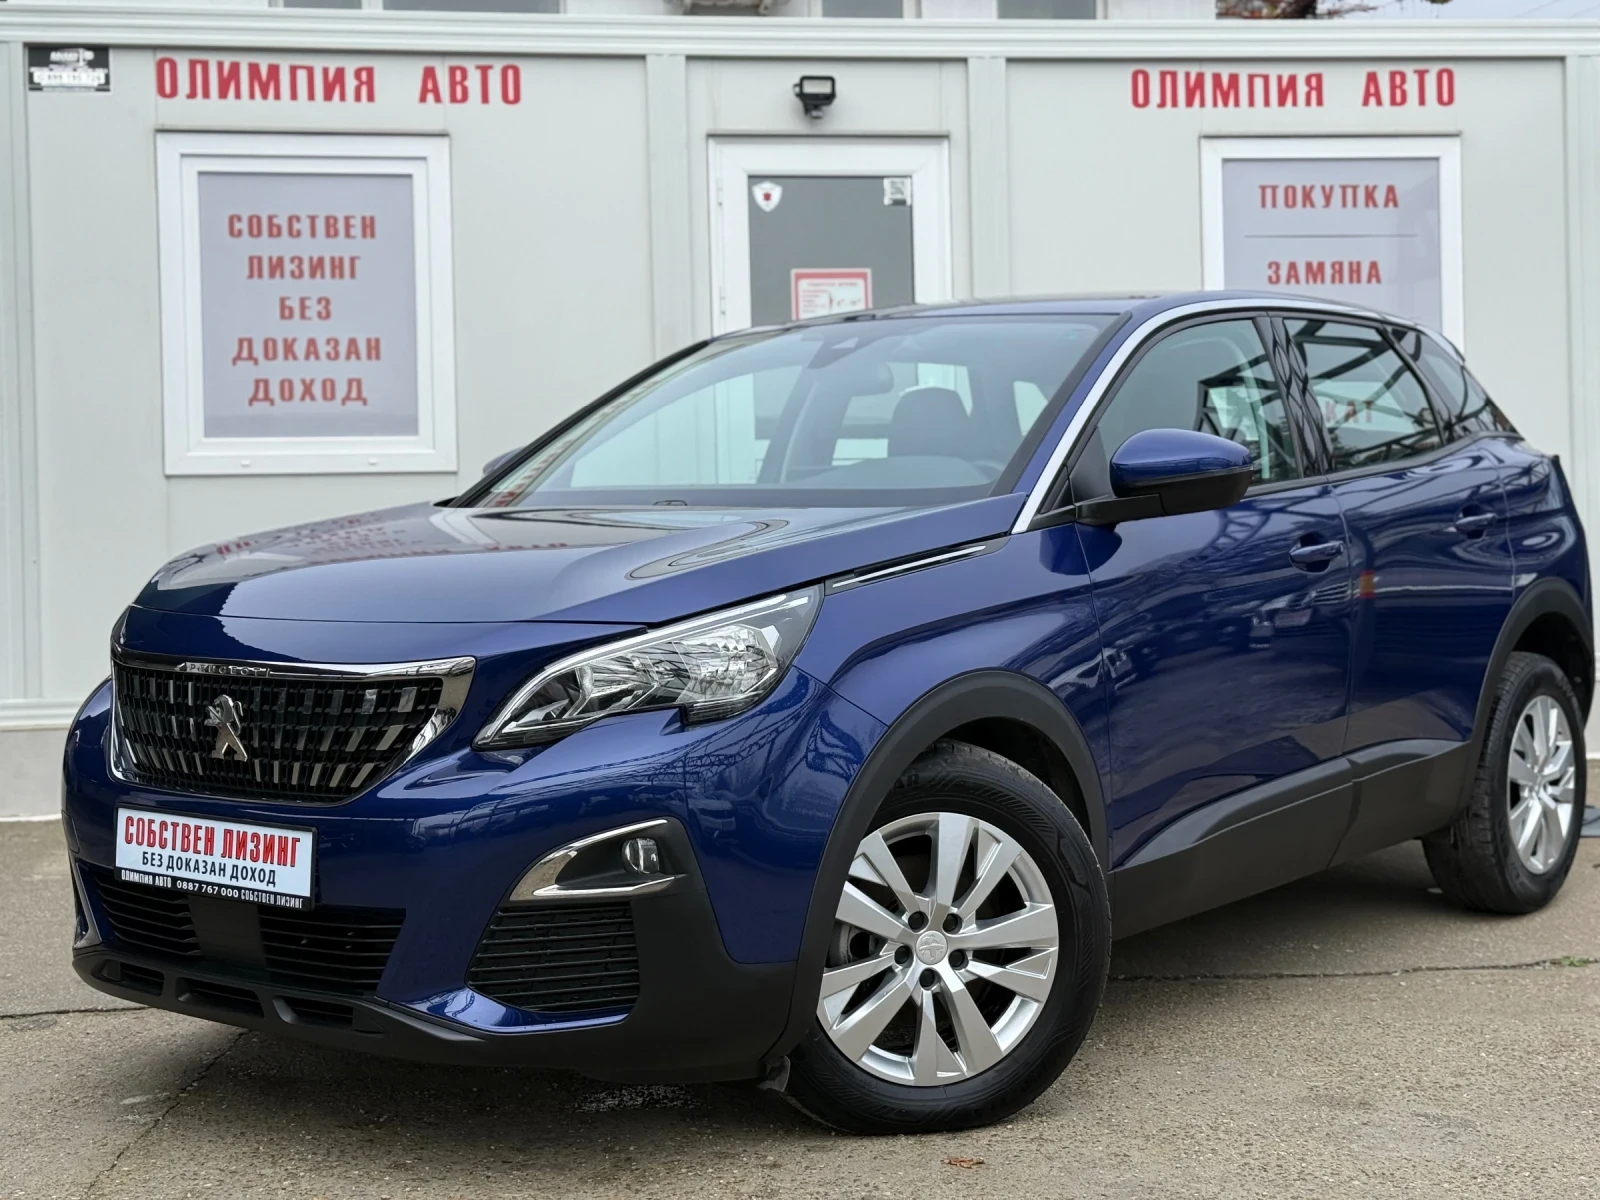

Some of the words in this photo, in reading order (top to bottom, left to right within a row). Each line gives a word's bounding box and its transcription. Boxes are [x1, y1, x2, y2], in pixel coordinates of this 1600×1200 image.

[155, 57, 376, 103] ОЛИМПИЯ
[417, 63, 522, 105] АВТО
[1130, 68, 1325, 109] ОЛИМПИЯ
[1361, 67, 1456, 107] АВТО
[1259, 184, 1399, 209] ПОКУПКА
[228, 214, 376, 239] СОБСТВЕН
[247, 255, 361, 280] ЛИЗИНГ
[1267, 260, 1382, 285] ЗАМЯНА
[278, 296, 332, 321] БЕЗ
[232, 337, 381, 365] ДОКАЗАН
[248, 377, 368, 406] ДОХОД
[189, 663, 261, 677] PEUGEOT
[124, 815, 215, 856] СОБСТВЕН
[220, 828, 301, 867] ЛИЗИНГ
[142, 851, 163, 868] БЕЗ
[166, 855, 226, 877] ДОКАЗАН
[229, 864, 276, 888] ДОХОД
[121, 869, 153, 885] ОЛИМПИЯ
[154, 875, 172, 888] АВТО
[176, 880, 199, 891] 0887
[201, 884, 218, 894] 767
[220, 887, 239, 898] 000
[241, 889, 275, 905] СОБСТВЕН
[276, 895, 304, 909] ЛИЗИНГ
